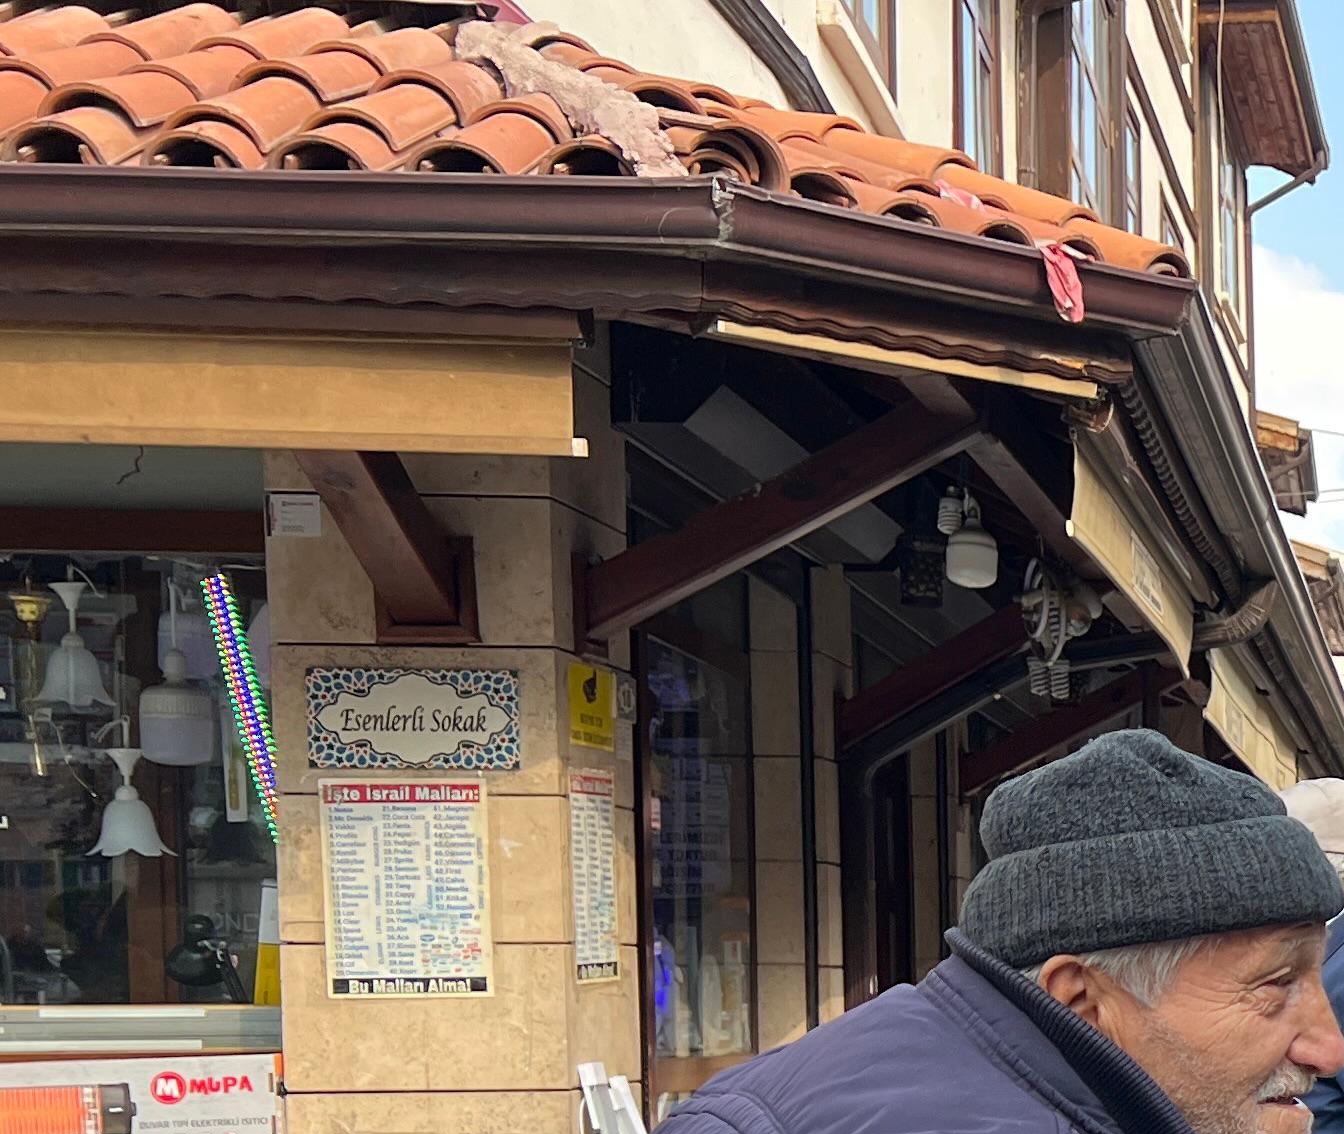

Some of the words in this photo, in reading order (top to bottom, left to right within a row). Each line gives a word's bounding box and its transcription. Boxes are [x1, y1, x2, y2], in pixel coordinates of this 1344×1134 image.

[340, 705, 425, 732] Esenlerli
[430, 705, 488, 733] Sokak
[349, 979, 369, 994] Bu
[373, 978, 424, 993] Malları
[428, 978, 472, 993] Alma!
